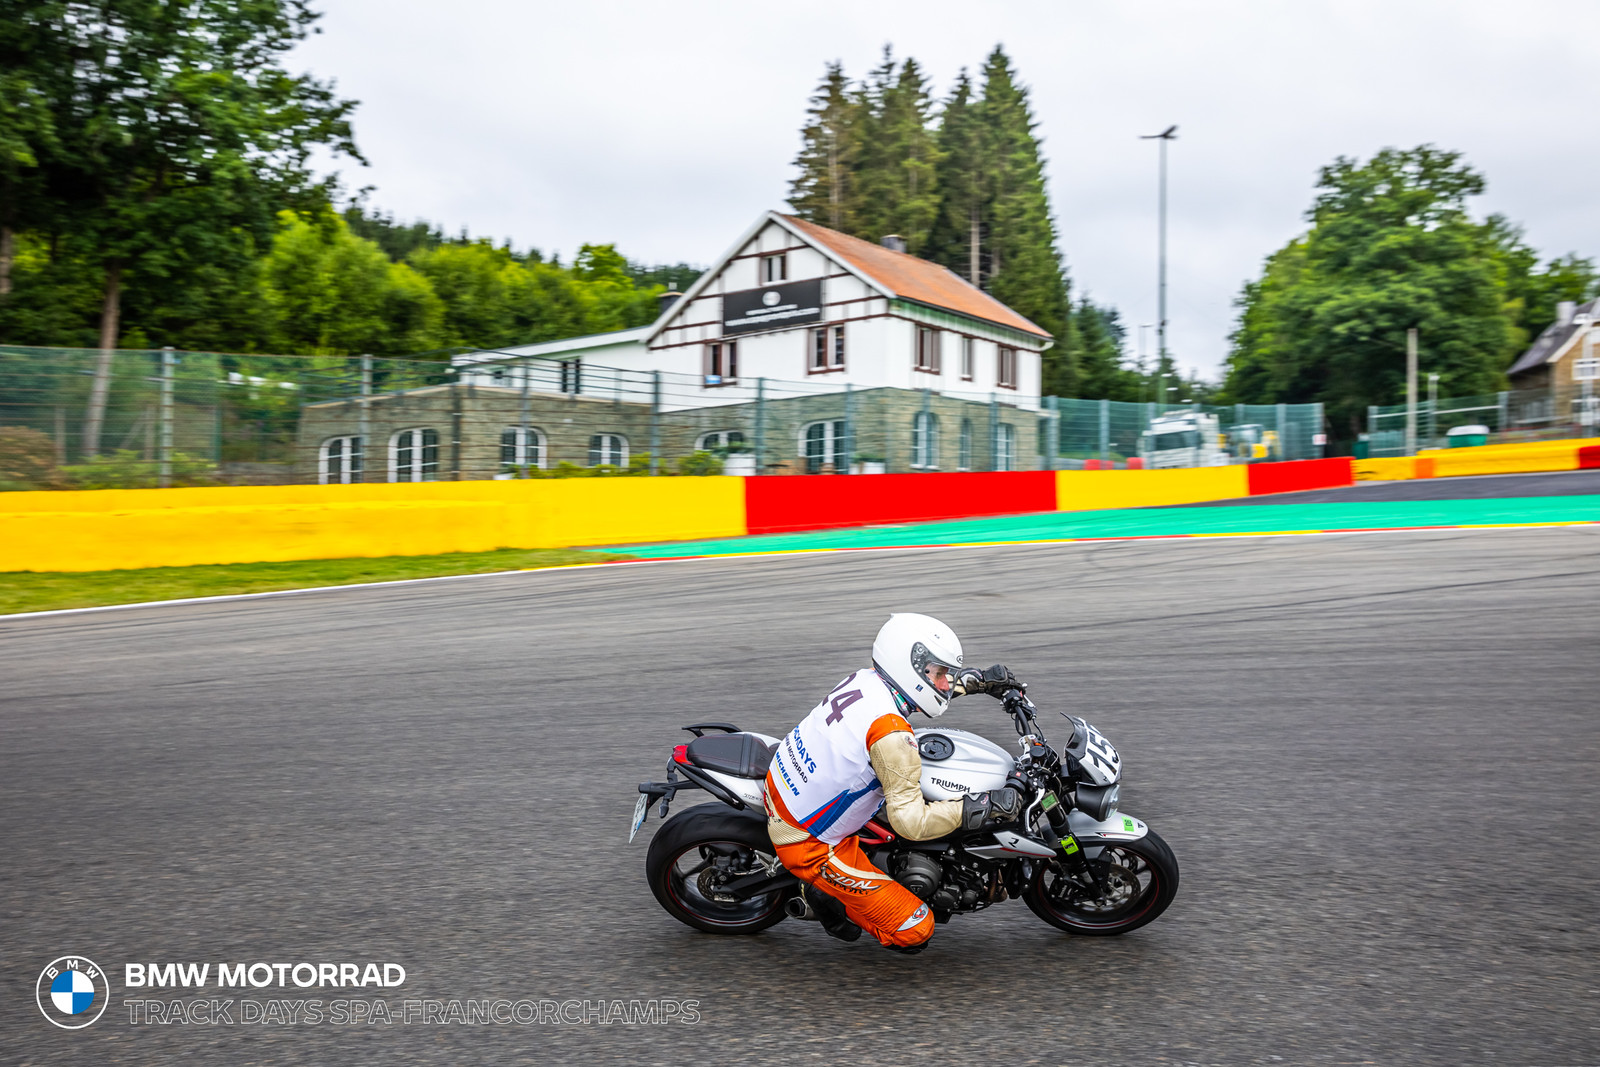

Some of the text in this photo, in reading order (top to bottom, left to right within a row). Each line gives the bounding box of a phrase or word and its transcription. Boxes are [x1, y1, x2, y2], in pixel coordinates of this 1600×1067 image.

[775, 752, 800, 796] MICHELIN
[786, 747, 808, 783] MOTORRAD
[931, 777, 971, 793] TRIUMPH
